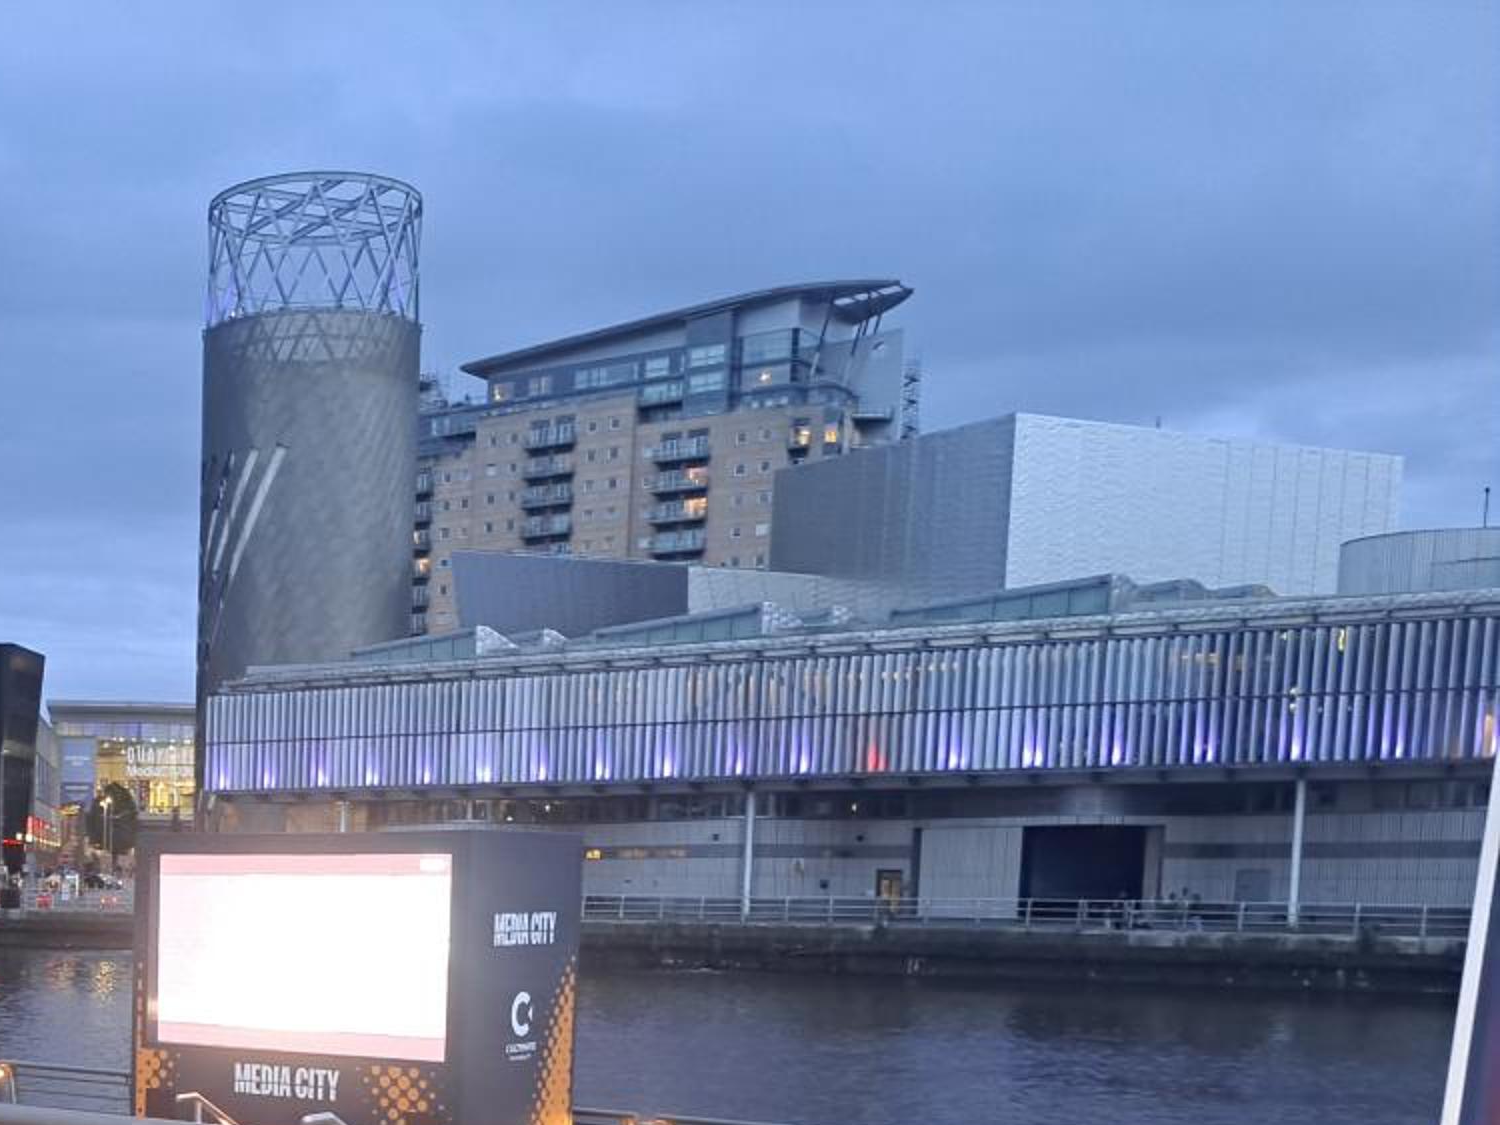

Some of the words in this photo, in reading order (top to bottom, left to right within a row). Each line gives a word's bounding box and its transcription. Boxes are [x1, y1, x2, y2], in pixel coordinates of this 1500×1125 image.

[493, 912, 529, 947] MEDIA
[530, 911, 557, 945] CITY
[233, 1062, 291, 1097] MEDIA
[294, 1066, 340, 1102] CITY
